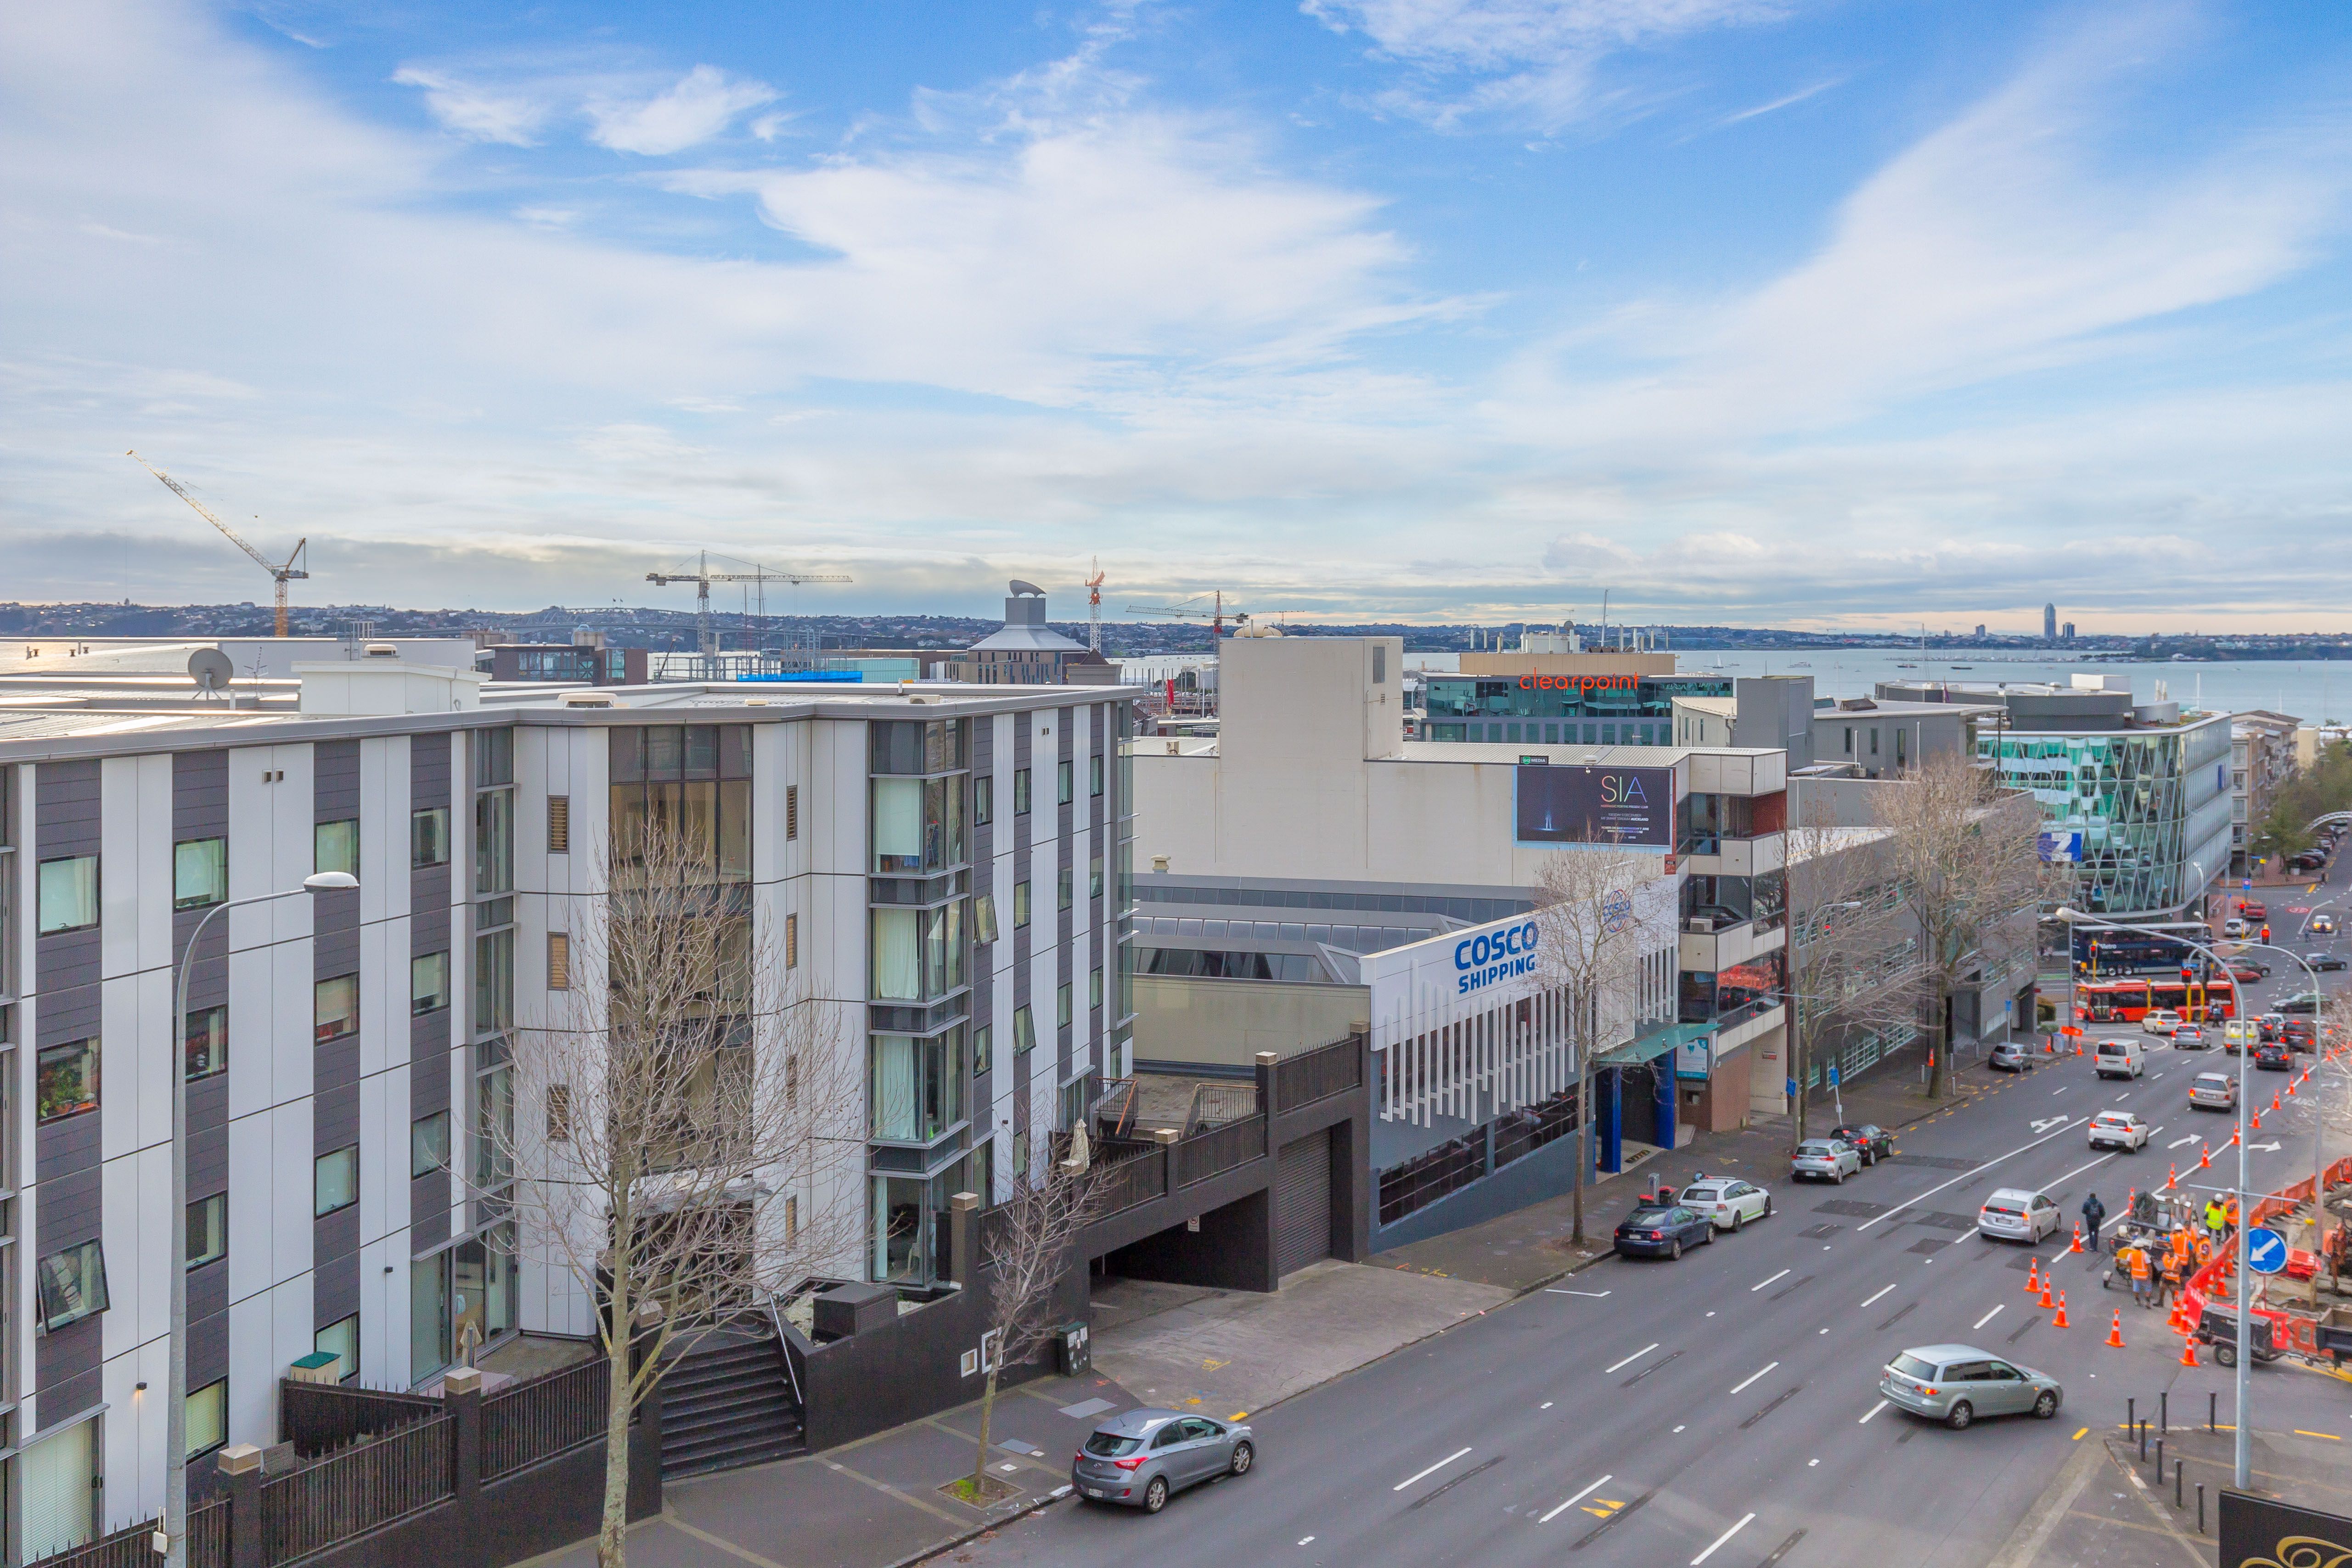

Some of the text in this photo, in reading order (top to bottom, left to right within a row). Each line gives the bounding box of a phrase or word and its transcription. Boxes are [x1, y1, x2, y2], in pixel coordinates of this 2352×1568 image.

[1519, 667, 1639, 696] clearpoint
[1601, 776, 1647, 803] SIA
[2051, 832, 2072, 861] Z
[1455, 921, 1539, 971] COSCO
[1459, 954, 1535, 994] SHIPPING
